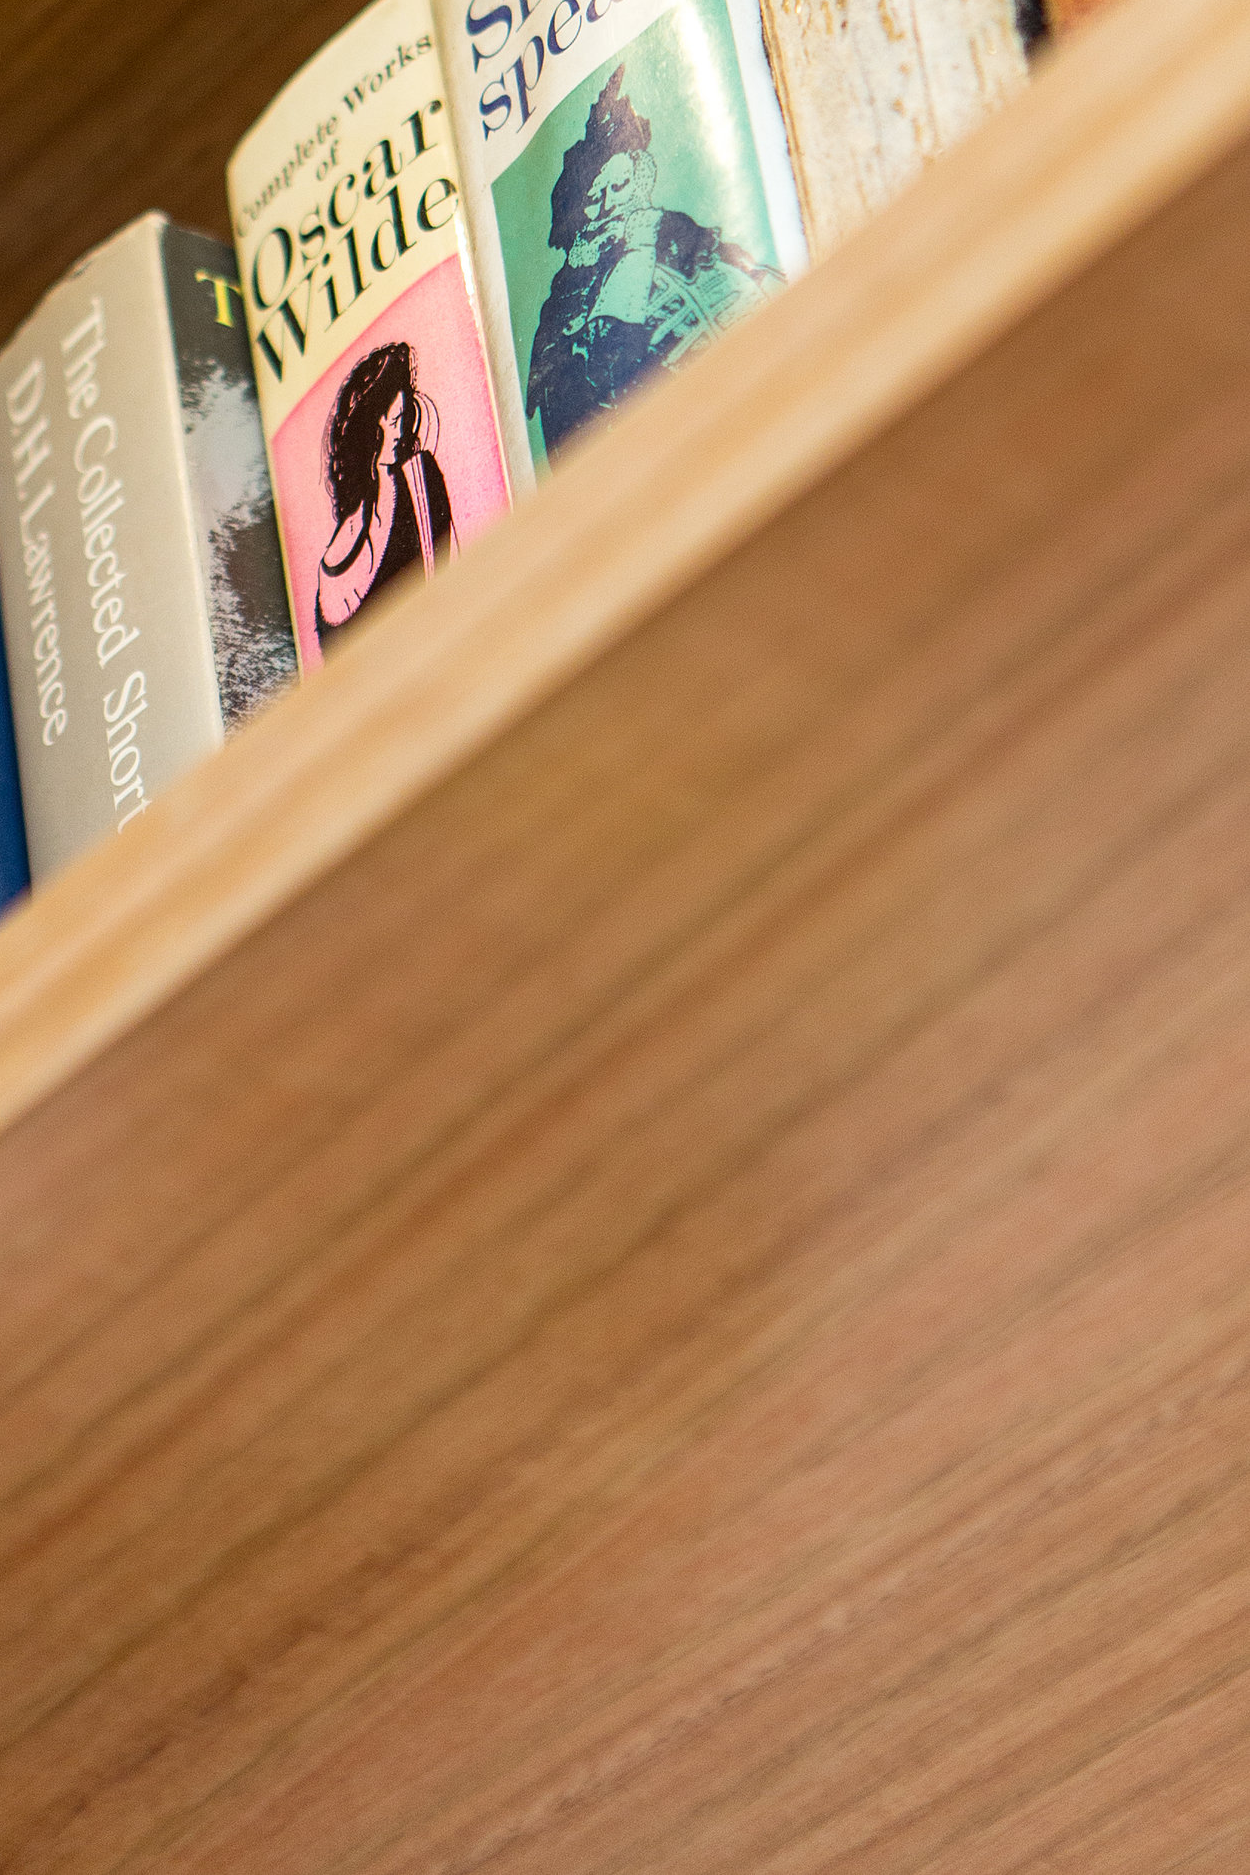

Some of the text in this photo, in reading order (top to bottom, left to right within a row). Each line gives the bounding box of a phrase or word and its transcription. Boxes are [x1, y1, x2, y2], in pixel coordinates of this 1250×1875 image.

[236, 34, 433, 238] Complete Works
[252, 99, 442, 311] Oscar
[315, 138, 340, 182] of
[256, 178, 459, 383] Wilde
[60, 295, 152, 835] The Collected Short
